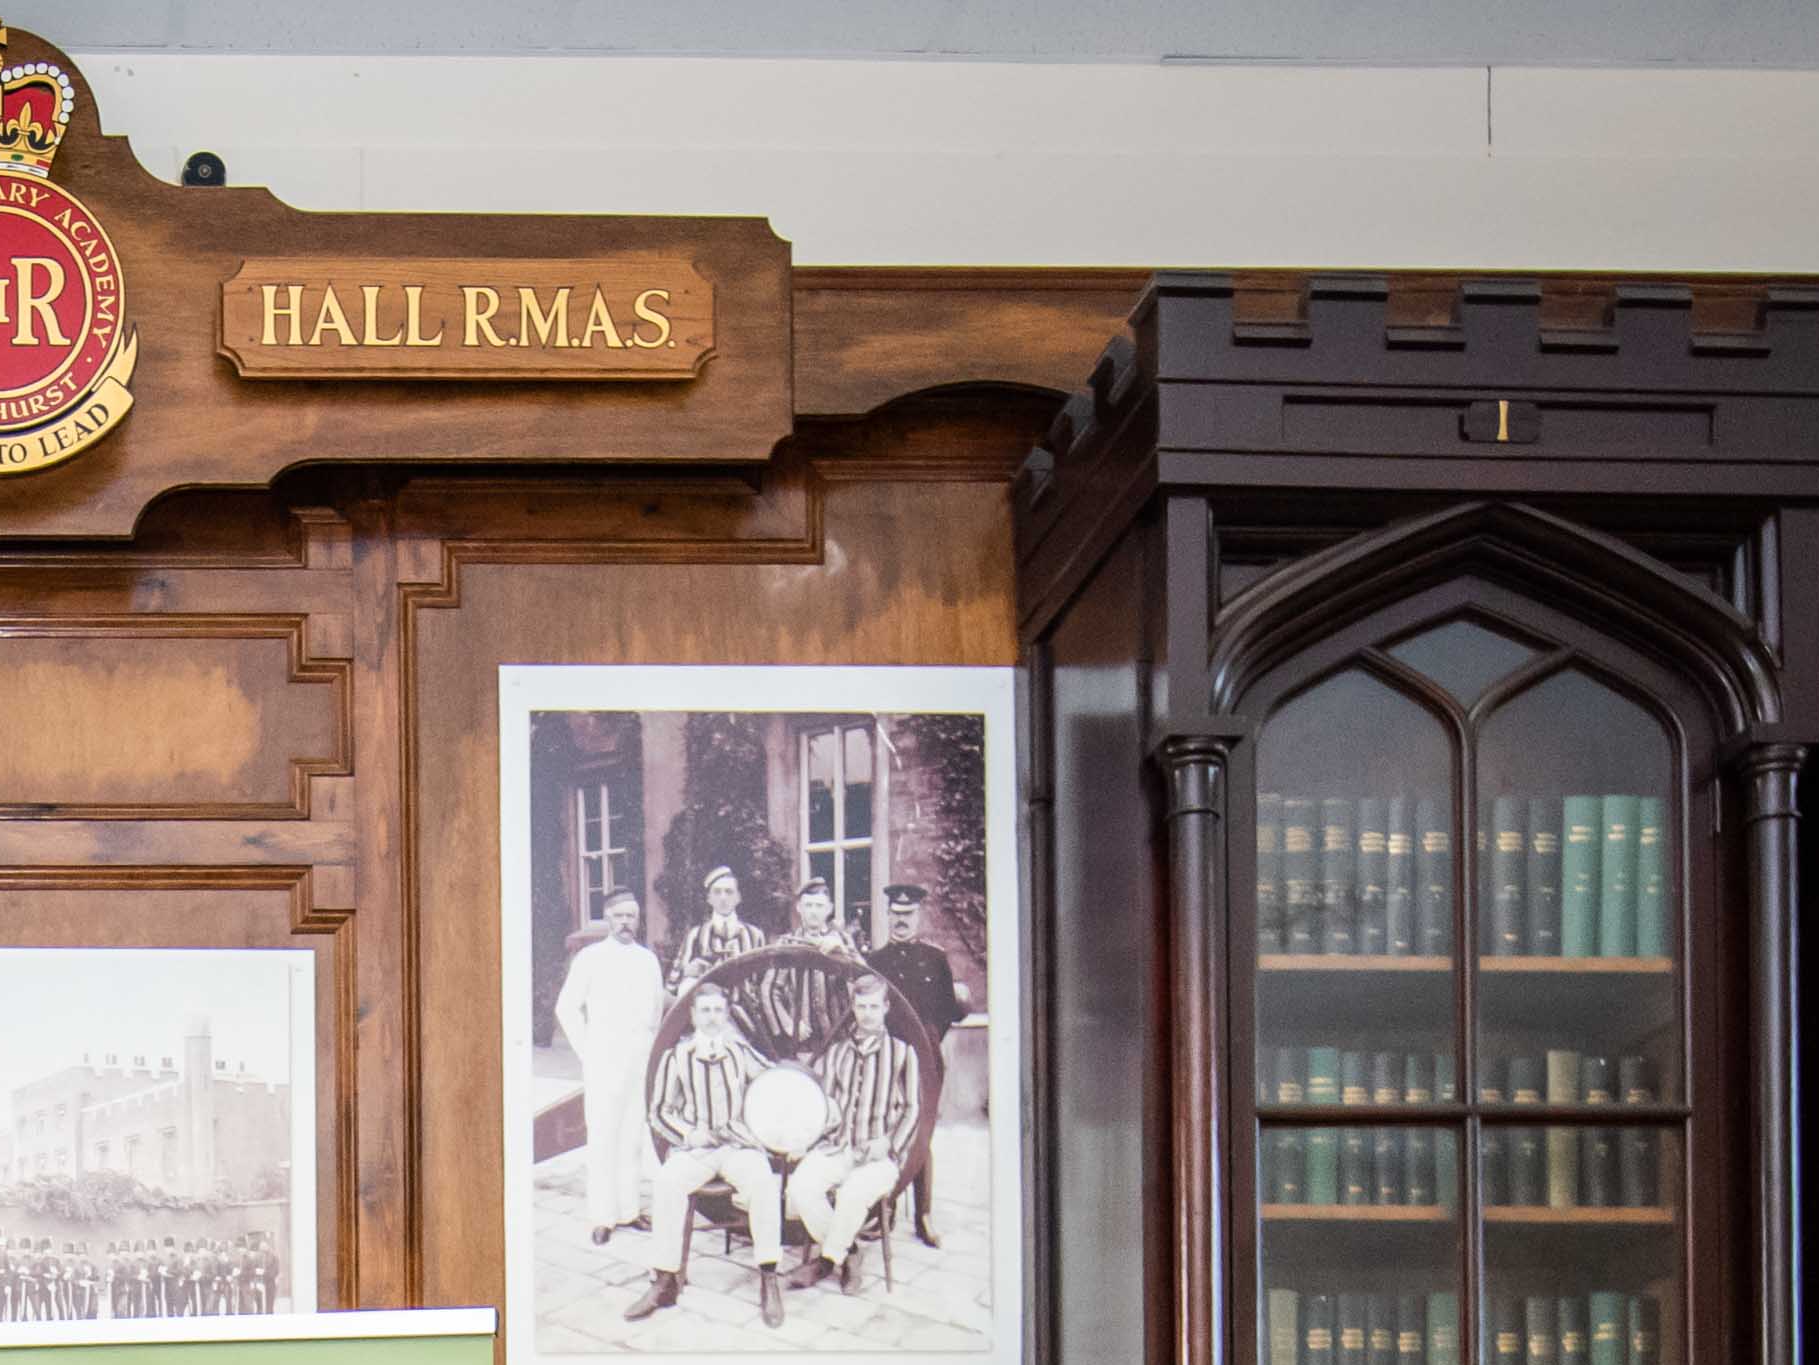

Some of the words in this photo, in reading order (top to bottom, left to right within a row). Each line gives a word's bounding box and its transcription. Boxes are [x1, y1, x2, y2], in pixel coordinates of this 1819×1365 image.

[54, 207, 115, 349] ACADEMY
[260, 282, 445, 348] HALL
[37, 401, 110, 458] LEAD
